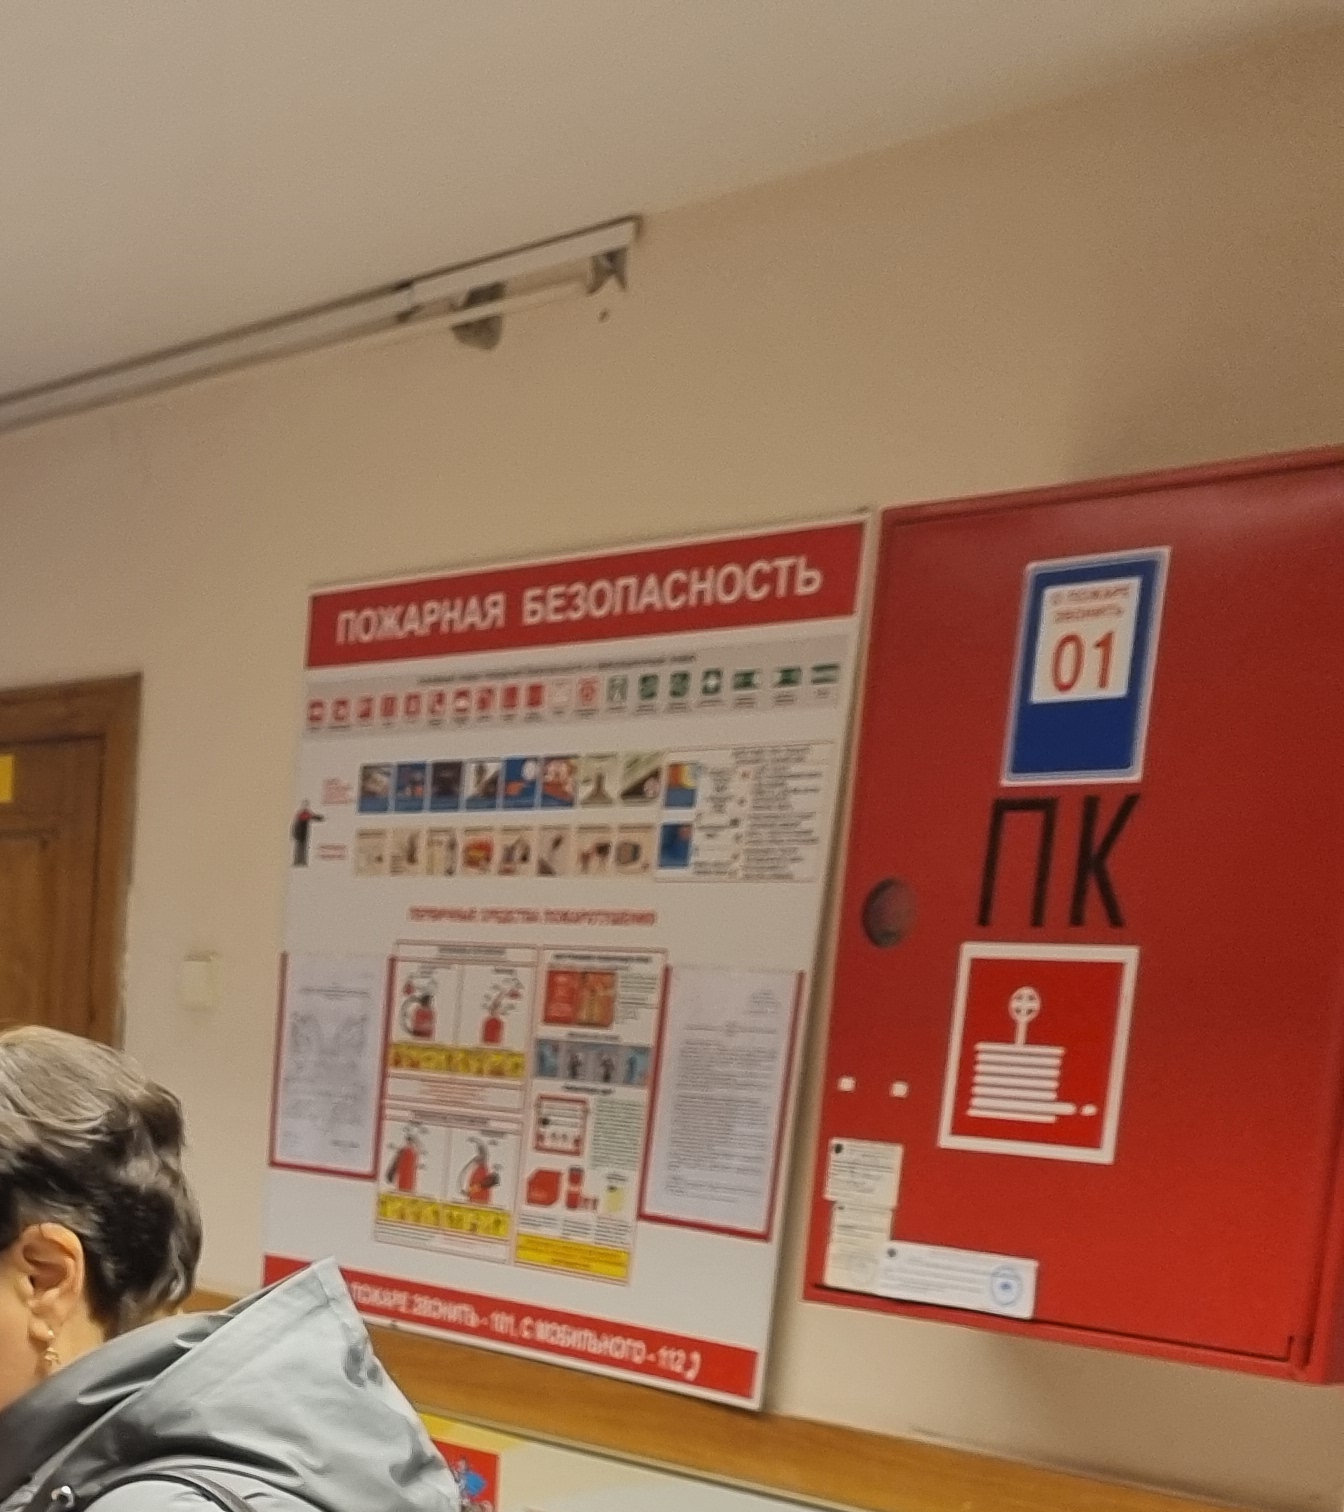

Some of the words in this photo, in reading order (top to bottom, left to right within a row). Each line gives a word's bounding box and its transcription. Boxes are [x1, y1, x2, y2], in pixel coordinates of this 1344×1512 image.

[335, 593, 506, 645] ПОЖАРНАЯ
[522, 555, 824, 625] БЕЗОПАСНОСТЬ
[1053, 632, 1114, 692] 01
[977, 792, 1140, 927] ПК
[412, 1292, 479, 1328] ЗВОНИТЬ
[520, 1316, 533, 1339] С
[535, 1320, 646, 1365] МОБИЛЬНОГО
